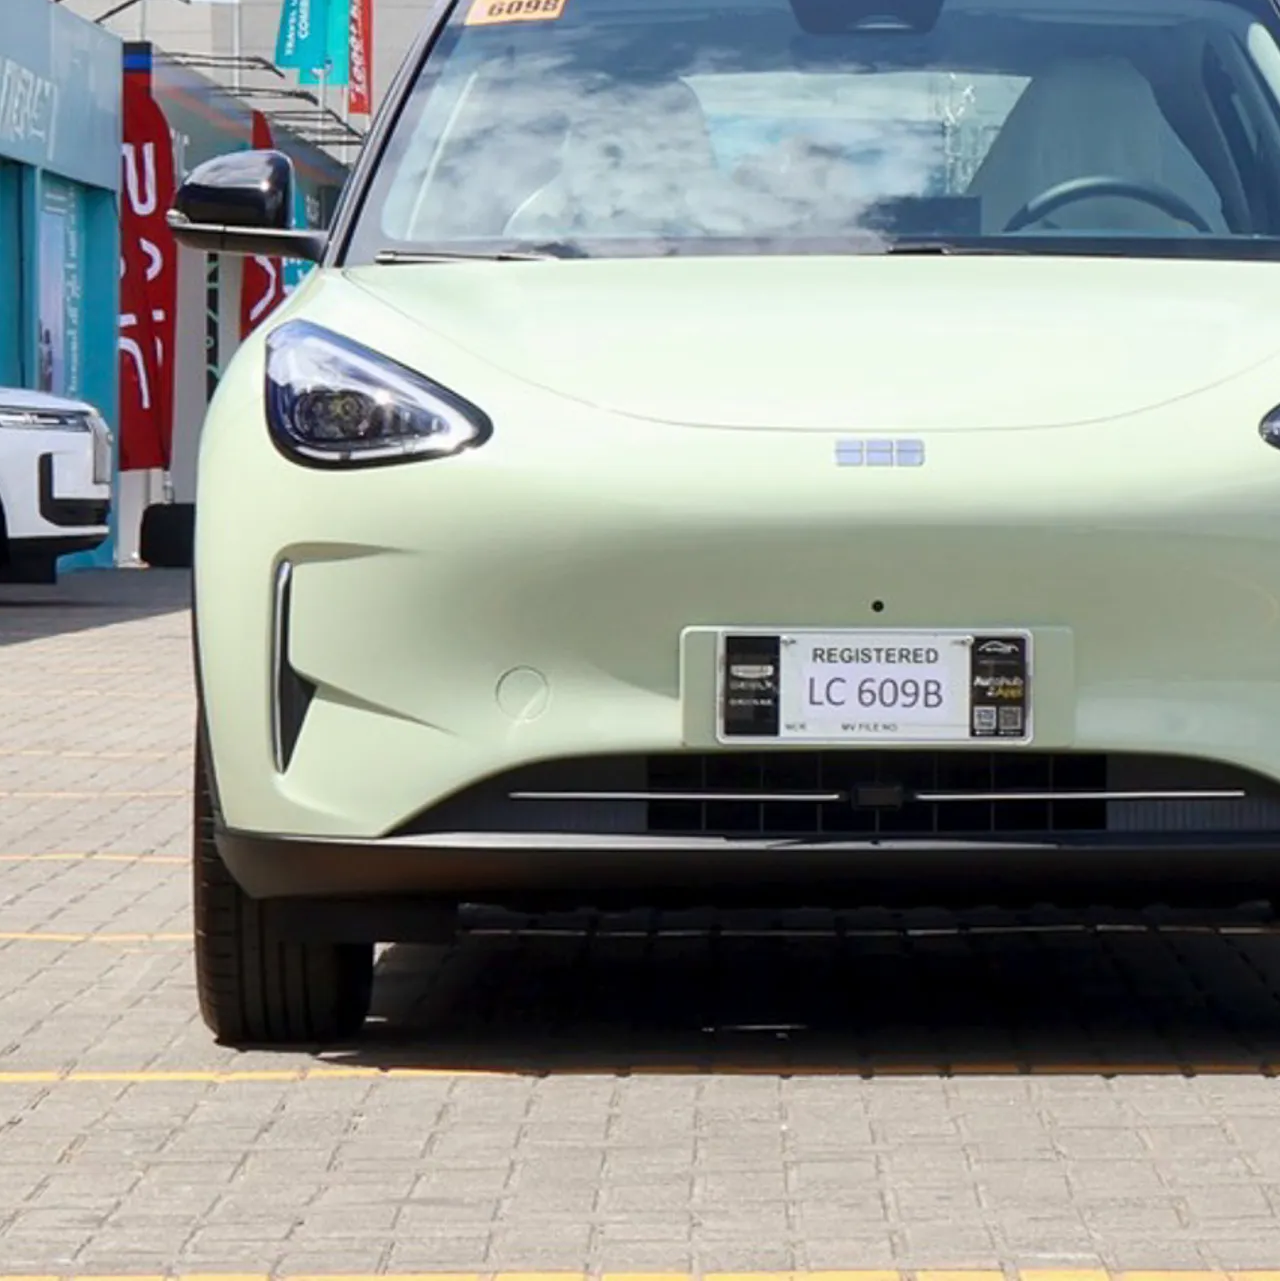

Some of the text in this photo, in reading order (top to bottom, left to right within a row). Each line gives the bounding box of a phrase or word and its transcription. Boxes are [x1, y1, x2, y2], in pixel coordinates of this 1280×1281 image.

[811, 647, 940, 665] REGISTERED
[808, 676, 944, 709] LC 609B
[858, 723, 879, 732] FILE
